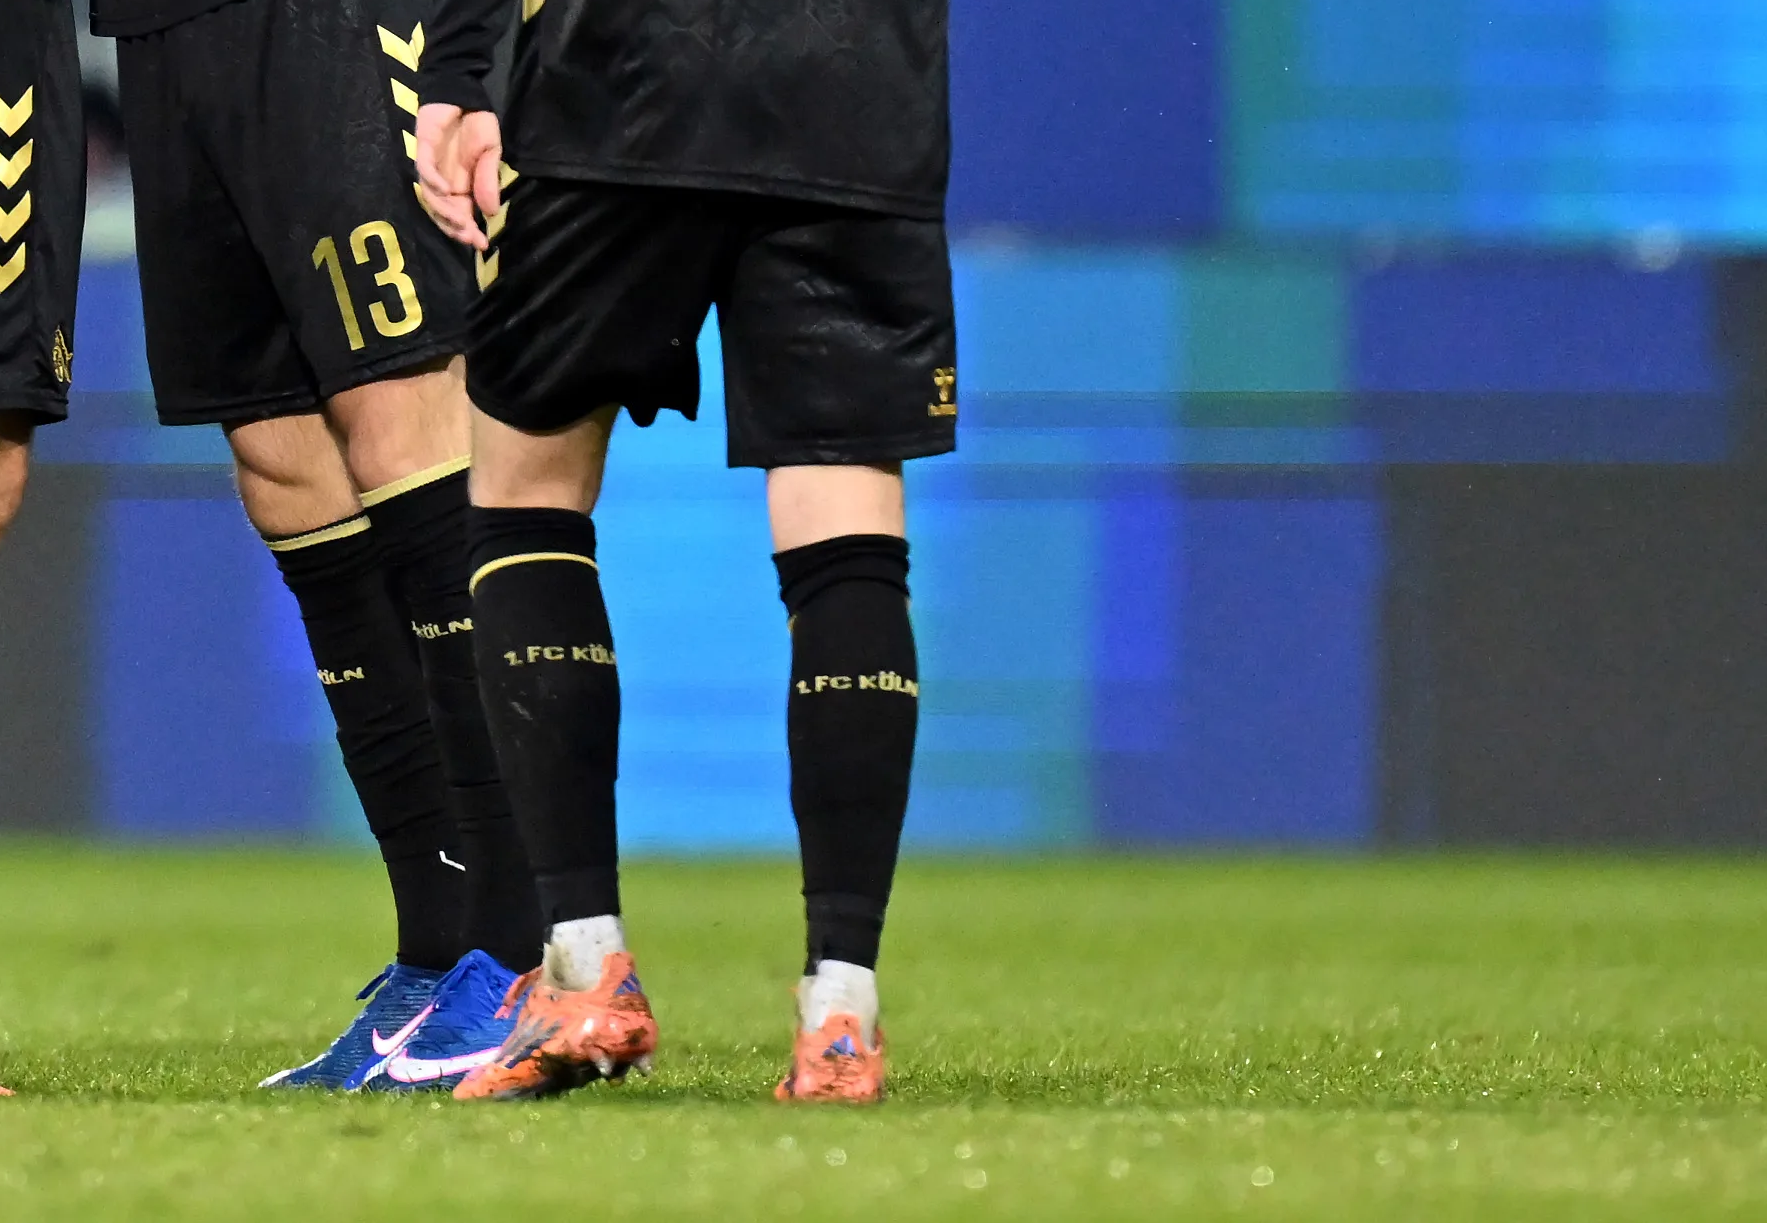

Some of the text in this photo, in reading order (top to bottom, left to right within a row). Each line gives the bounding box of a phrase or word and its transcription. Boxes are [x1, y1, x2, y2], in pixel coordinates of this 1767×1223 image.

[311, 220, 423, 351] 13
[526, 645, 565, 663] FC
[814, 675, 853, 693] FC
